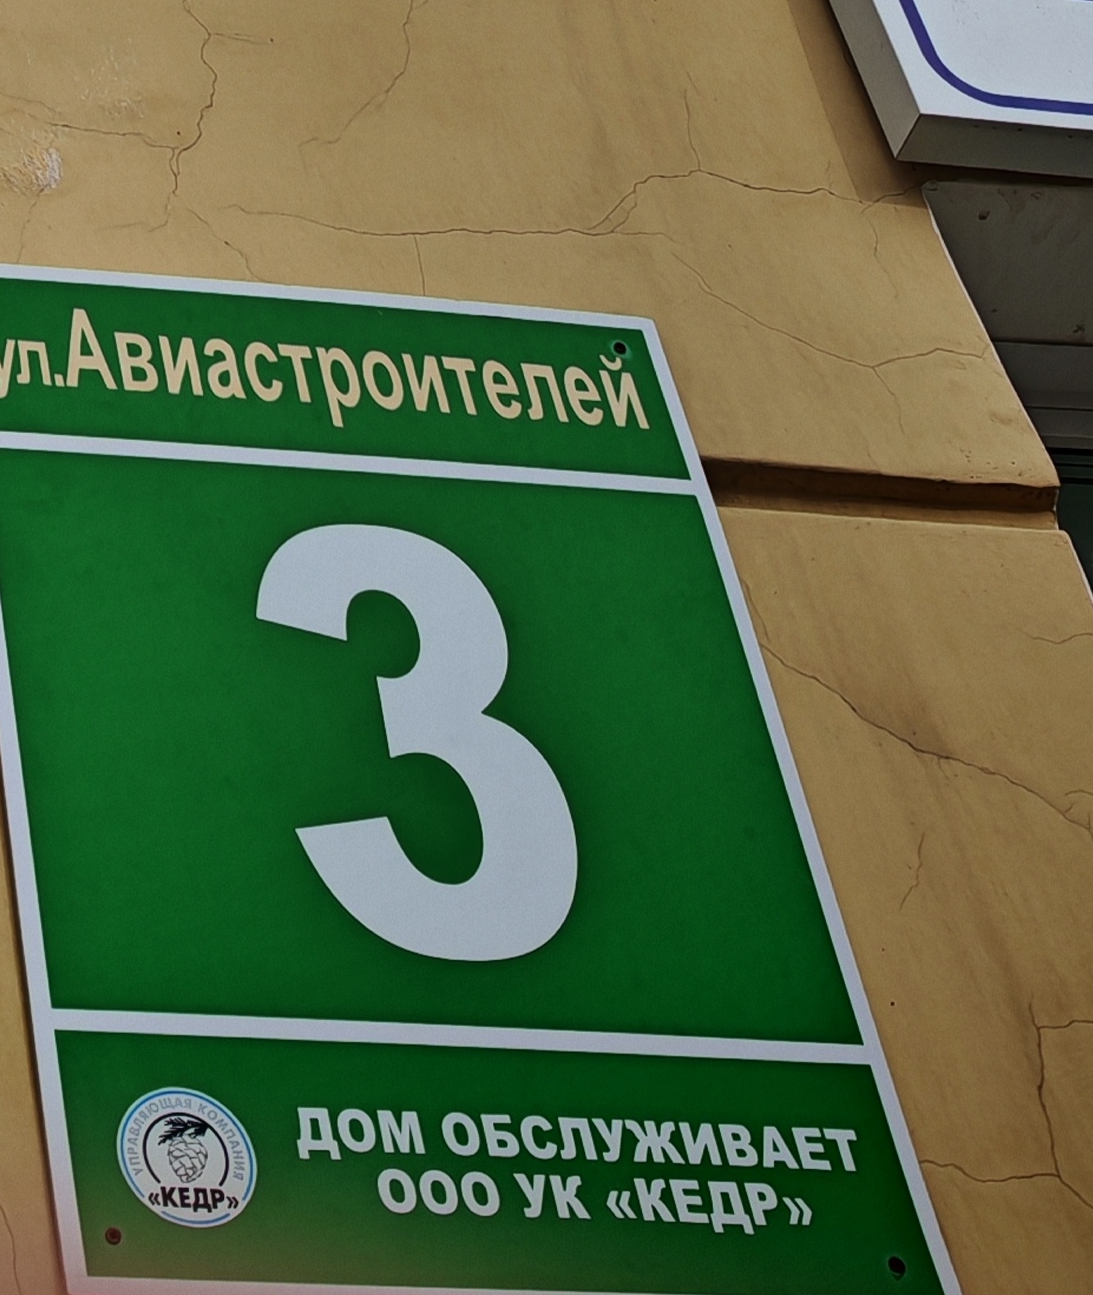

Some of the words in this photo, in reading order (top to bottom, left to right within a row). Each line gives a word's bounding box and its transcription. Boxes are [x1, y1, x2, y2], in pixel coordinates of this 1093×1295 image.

[256, 524, 578, 961] 3
[127, 1097, 193, 1176] УПРАВЛЯЮЩАЯ
[197, 1103, 246, 1181] КОМПАНИЯ
[297, 1107, 426, 1160] ДОМ
[441, 1112, 857, 1172] ОБСЛУЖИВАЕТ
[148, 1186, 240, 1213] «КЕДР»
[377, 1168, 500, 1217] ООО
[513, 1173, 591, 1220] УК
[606, 1178, 813, 1235] «КЕДР»
